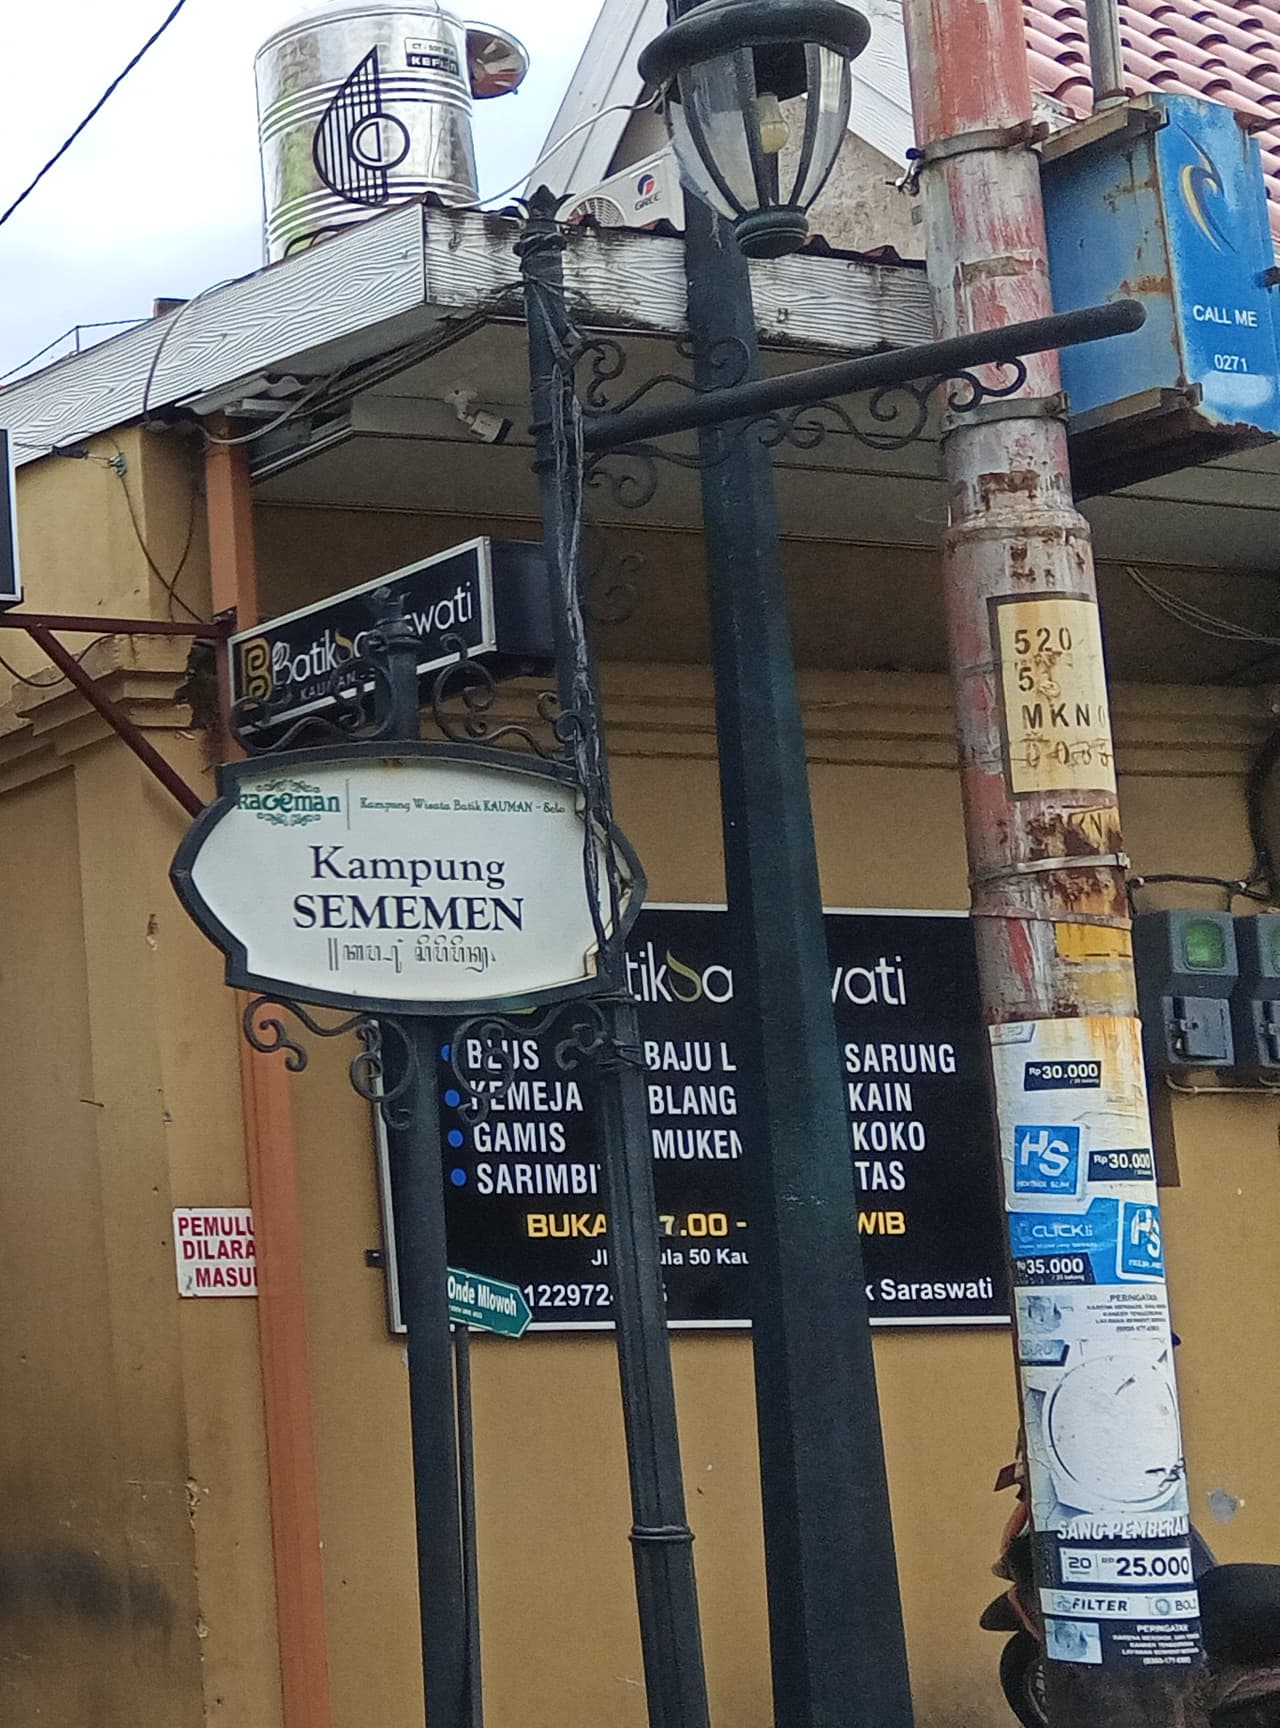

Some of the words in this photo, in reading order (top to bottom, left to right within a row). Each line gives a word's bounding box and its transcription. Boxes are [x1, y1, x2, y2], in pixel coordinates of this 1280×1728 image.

[1192, 303, 1233, 325] CALL
[1234, 309, 1258, 328] ME
[1214, 353, 1248, 373] 0271
[1014, 626, 1073, 655] 520
[482, 799, 534, 813] KAUMAN
[307, 844, 506, 890] Kampung
[292, 893, 525, 932] SEMEMEN
[643, 1040, 712, 1072] BAJU
[844, 1042, 957, 1074] SARUNG
[469, 1080, 584, 1112] KEMEJA
[847, 1082, 914, 1112] KAIN
[472, 1121, 567, 1153] GAMIS
[851, 1120, 927, 1152] KOKO
[1020, 1129, 1070, 1178] HS
[476, 1162, 601, 1195] SARIMBI
[854, 1160, 907, 1191] TAS
[526, 1213, 608, 1238] BUKA
[182, 1239, 257, 1260] DILARA
[688, 1248, 711, 1265] 50
[195, 1266, 259, 1288] MASU
[880, 1276, 994, 1301] Saraswati
[447, 1275, 476, 1305] Onde
[1067, 1556, 1092, 1570] 20
[1115, 1556, 1190, 1577] 25.000
[1072, 1598, 1128, 1613] FILTER
